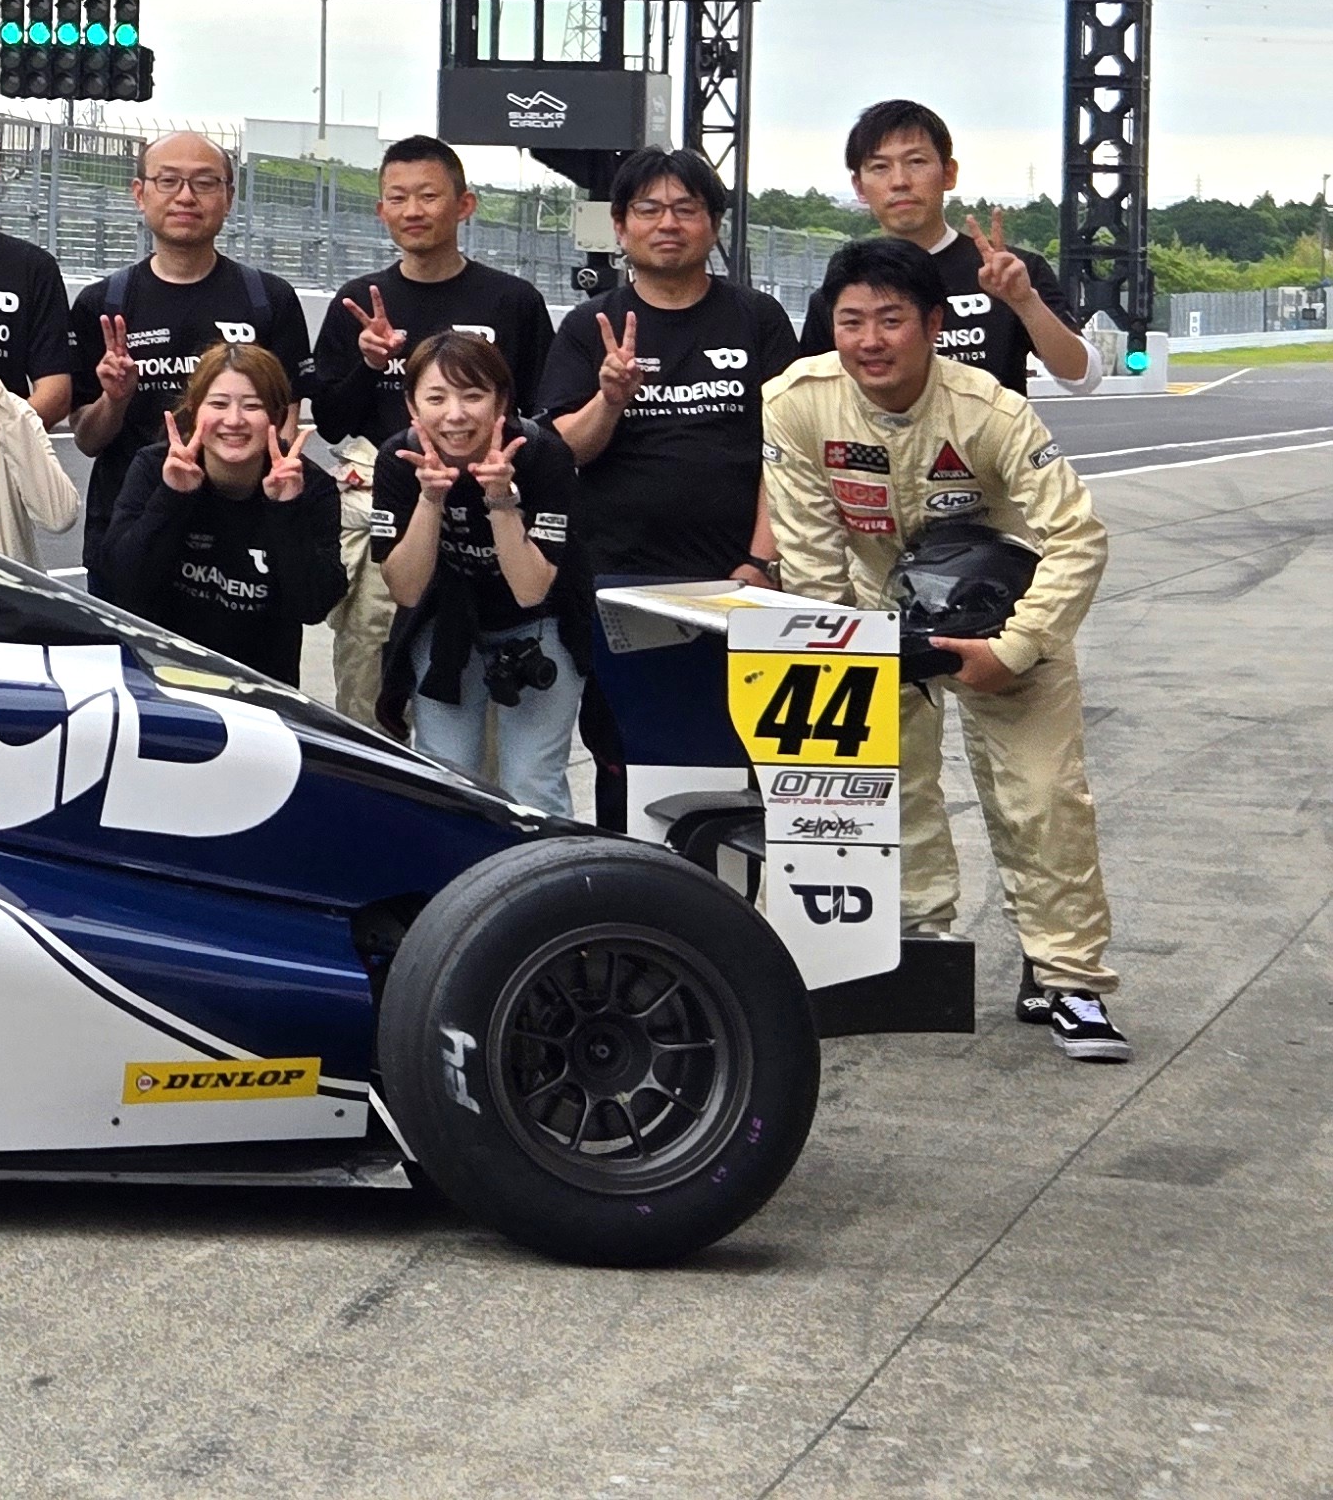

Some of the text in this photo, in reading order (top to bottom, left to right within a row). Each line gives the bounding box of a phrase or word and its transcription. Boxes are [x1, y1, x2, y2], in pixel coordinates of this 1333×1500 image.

[507, 111, 567, 121] SUZUKA
[509, 120, 564, 129] CIRCUIT
[634, 380, 745, 403] OKAIDENSO
[834, 482, 885, 503] NGK
[754, 663, 880, 758] 44
[162, 1069, 307, 1090] DUNLOP
